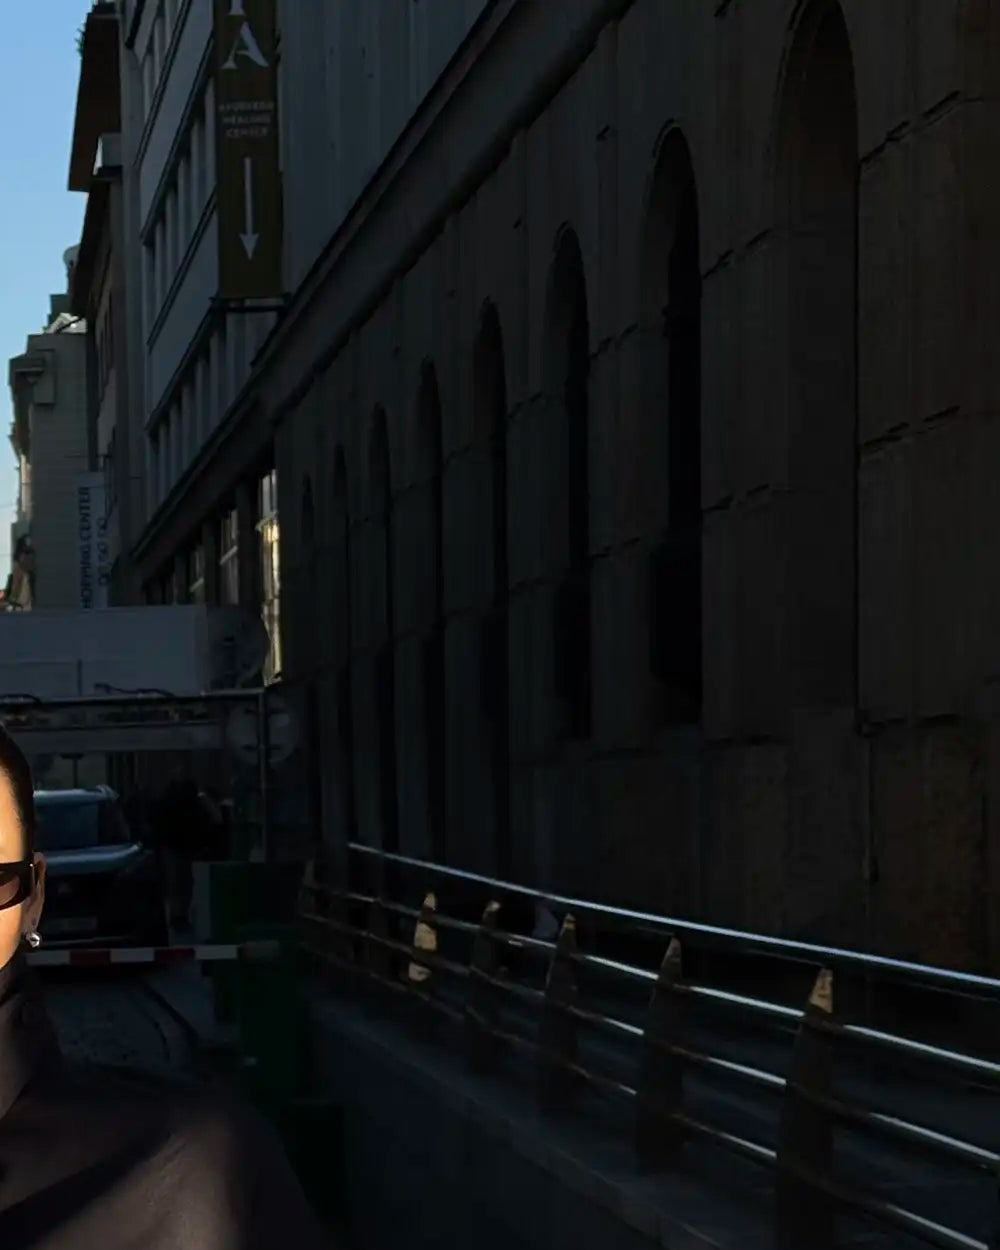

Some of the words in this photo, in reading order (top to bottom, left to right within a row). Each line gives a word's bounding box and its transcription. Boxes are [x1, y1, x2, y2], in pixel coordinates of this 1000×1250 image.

[220, 0, 270, 69] A
[79, 487, 91, 541] CENTER
[79, 544, 92, 608] HOPPING
